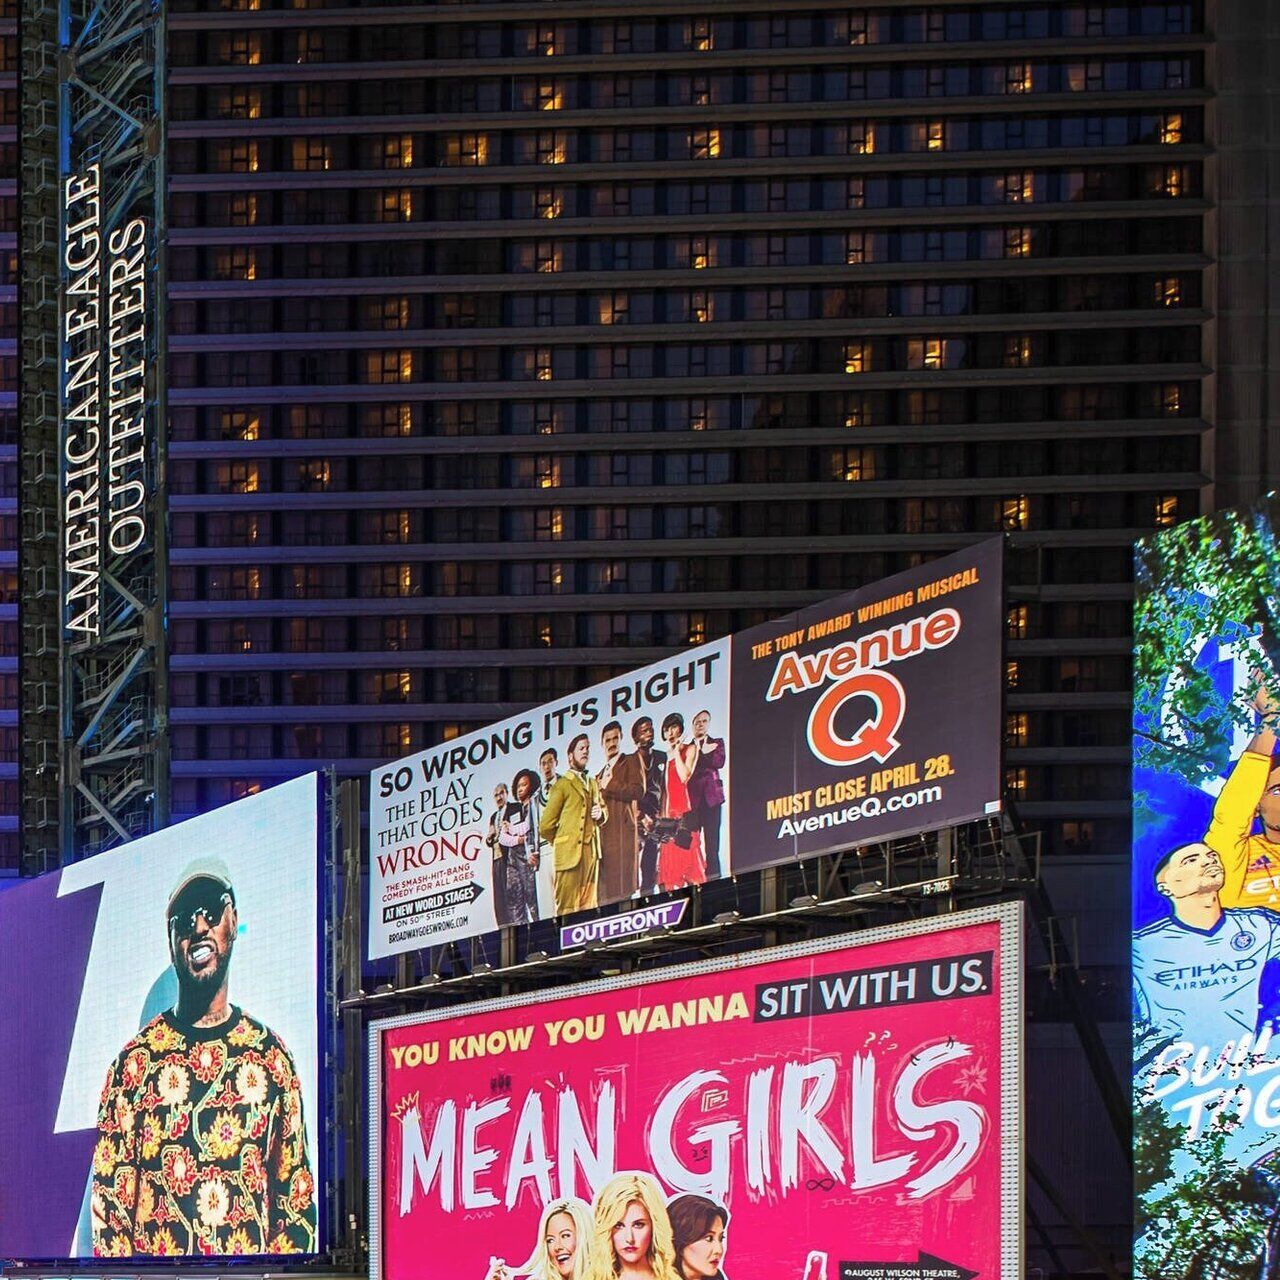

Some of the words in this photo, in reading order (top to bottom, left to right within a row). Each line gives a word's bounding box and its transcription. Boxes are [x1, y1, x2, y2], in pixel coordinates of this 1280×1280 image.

[65, 162, 101, 342] EAGLE
[108, 217, 145, 557] OUTFITTERS
[65, 351, 100, 636] AMERICAN
[752, 640, 772, 660] THE
[775, 630, 805, 653] TONY
[857, 591, 914, 624] WINNING
[917, 567, 980, 603] MUSICAL
[765, 607, 961, 702] Avenue
[380, 766, 413, 798] SO
[421, 719, 534, 782] WRONG
[609, 651, 721, 718] RIGHT
[807, 668, 906, 766] Q
[378, 820, 419, 848] THAT
[421, 796, 483, 837] GOES
[766, 790, 812, 821] MUST
[815, 776, 867, 808] CLOSE
[870, 763, 920, 794] APRIL
[924, 754, 955, 781] 28.
[777, 785, 942, 839] AvenueQ.com
[376, 831, 483, 878] WRONG
[384, 909, 394, 922] AT
[395, 904, 413, 918] NEW
[414, 895, 442, 913] WORLD
[443, 886, 475, 906] STAGES
[570, 907, 673, 944] OUTFRONT
[758, 981, 809, 1018] SIT
[817, 966, 919, 1009] WITH
[930, 958, 989, 996] US.
[1156, 957, 1259, 983] ETIHAD
[1172, 973, 1240, 992] AIRWAYS
[391, 1041, 440, 1070] YOU
[448, 1025, 534, 1063] KNOW
[544, 1016, 605, 1047] YOU
[617, 992, 749, 1037] WANNA
[398, 1077, 618, 1218] MEAN
[649, 1035, 985, 1201] GIRLS
